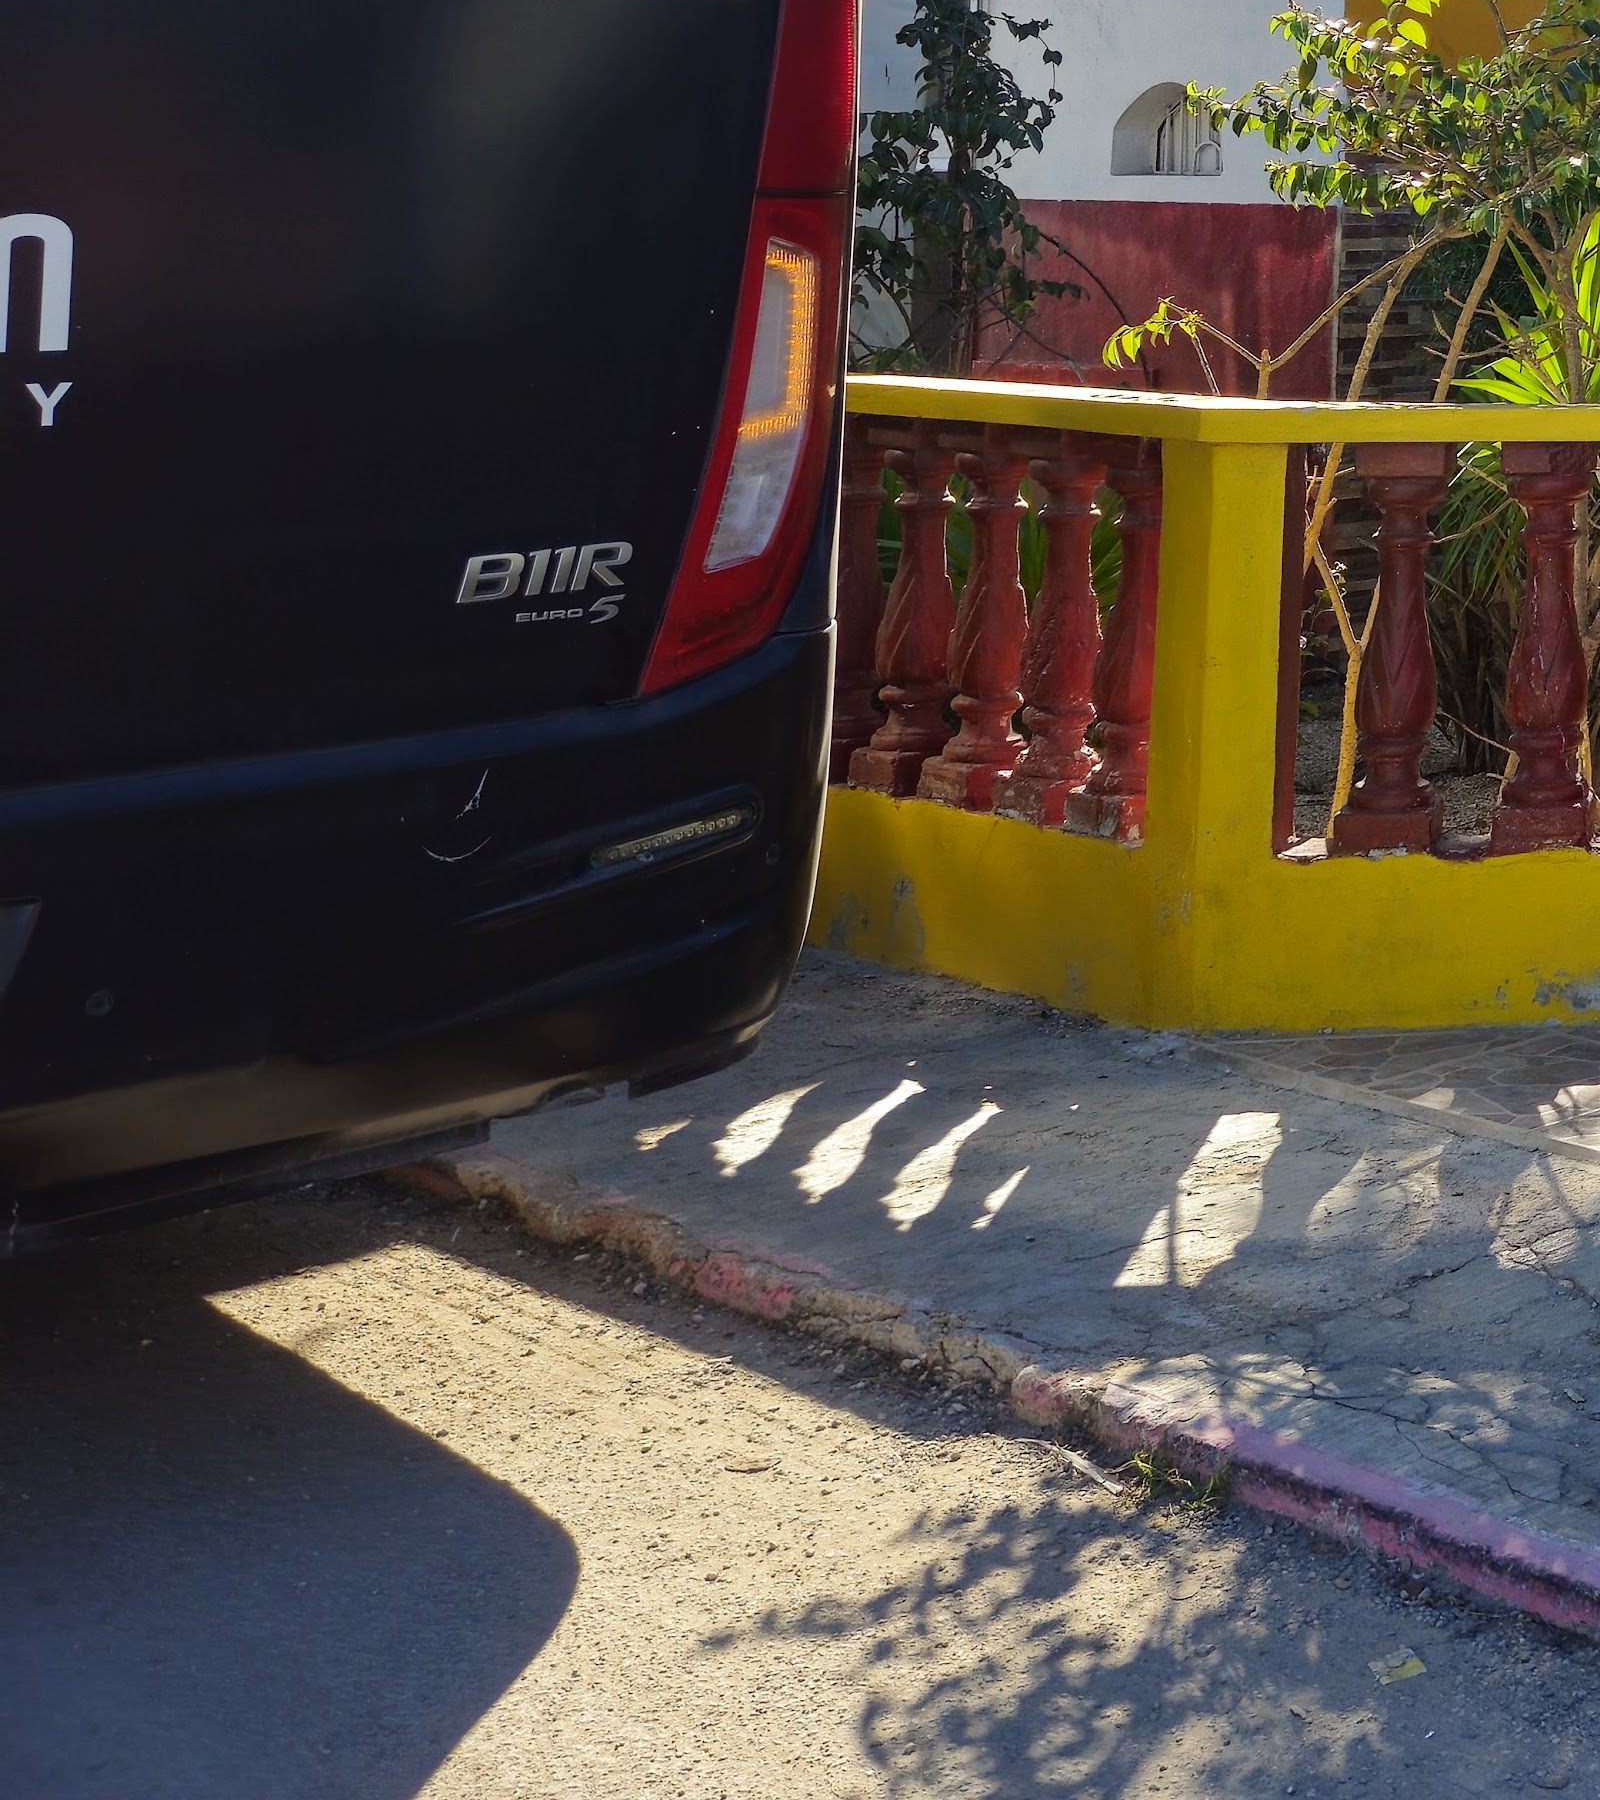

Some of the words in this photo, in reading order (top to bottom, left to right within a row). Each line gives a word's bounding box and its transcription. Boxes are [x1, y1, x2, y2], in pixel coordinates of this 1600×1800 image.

[456, 541, 634, 604] B11R
[515, 608, 584, 624] EURO
[589, 593, 626, 625] 5
